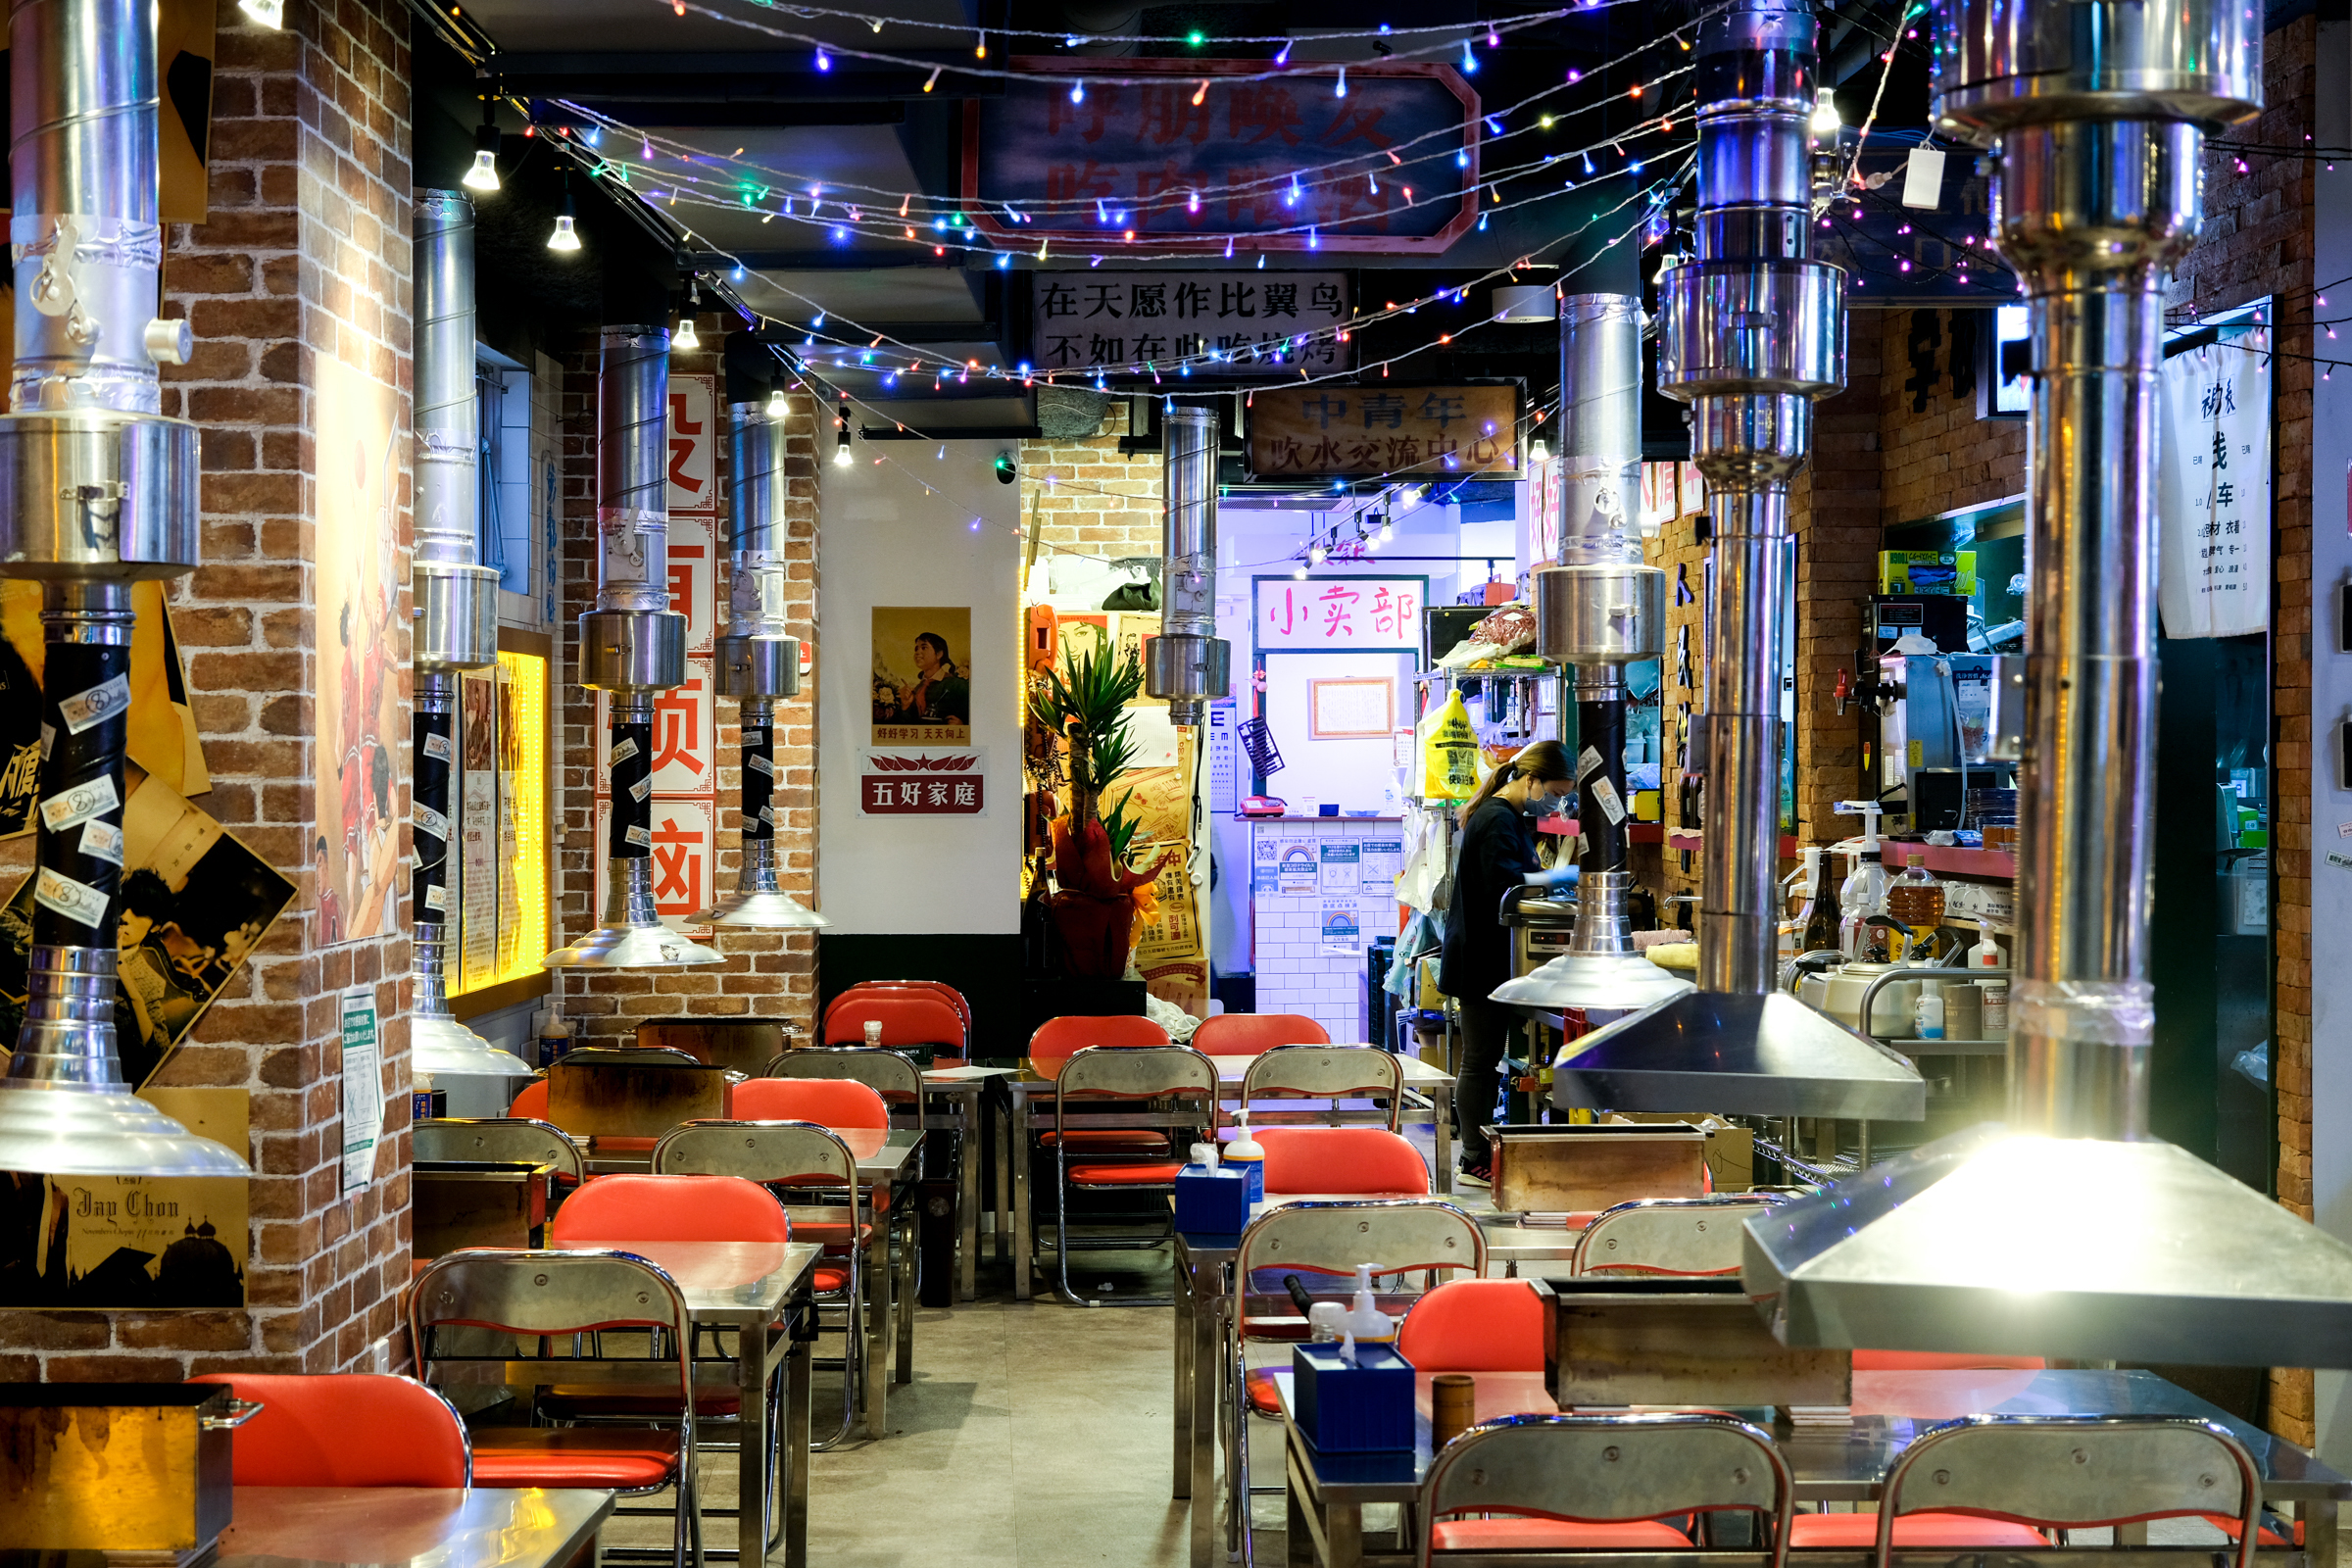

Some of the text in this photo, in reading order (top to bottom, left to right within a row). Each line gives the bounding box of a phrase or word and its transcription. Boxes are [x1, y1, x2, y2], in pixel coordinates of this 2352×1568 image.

[1039, 281, 1344, 319] 在天愿作比翼鸟
[1301, 392, 1467, 429] 中青年
[1270, 429, 1499, 470] 吹水交流中心
[1270, 585, 1414, 640] 小卖部
[877, 727, 965, 740] 好好学习 天天向上
[872, 781, 976, 807] 五好家庭
[73, 1187, 118, 1227] Jay
